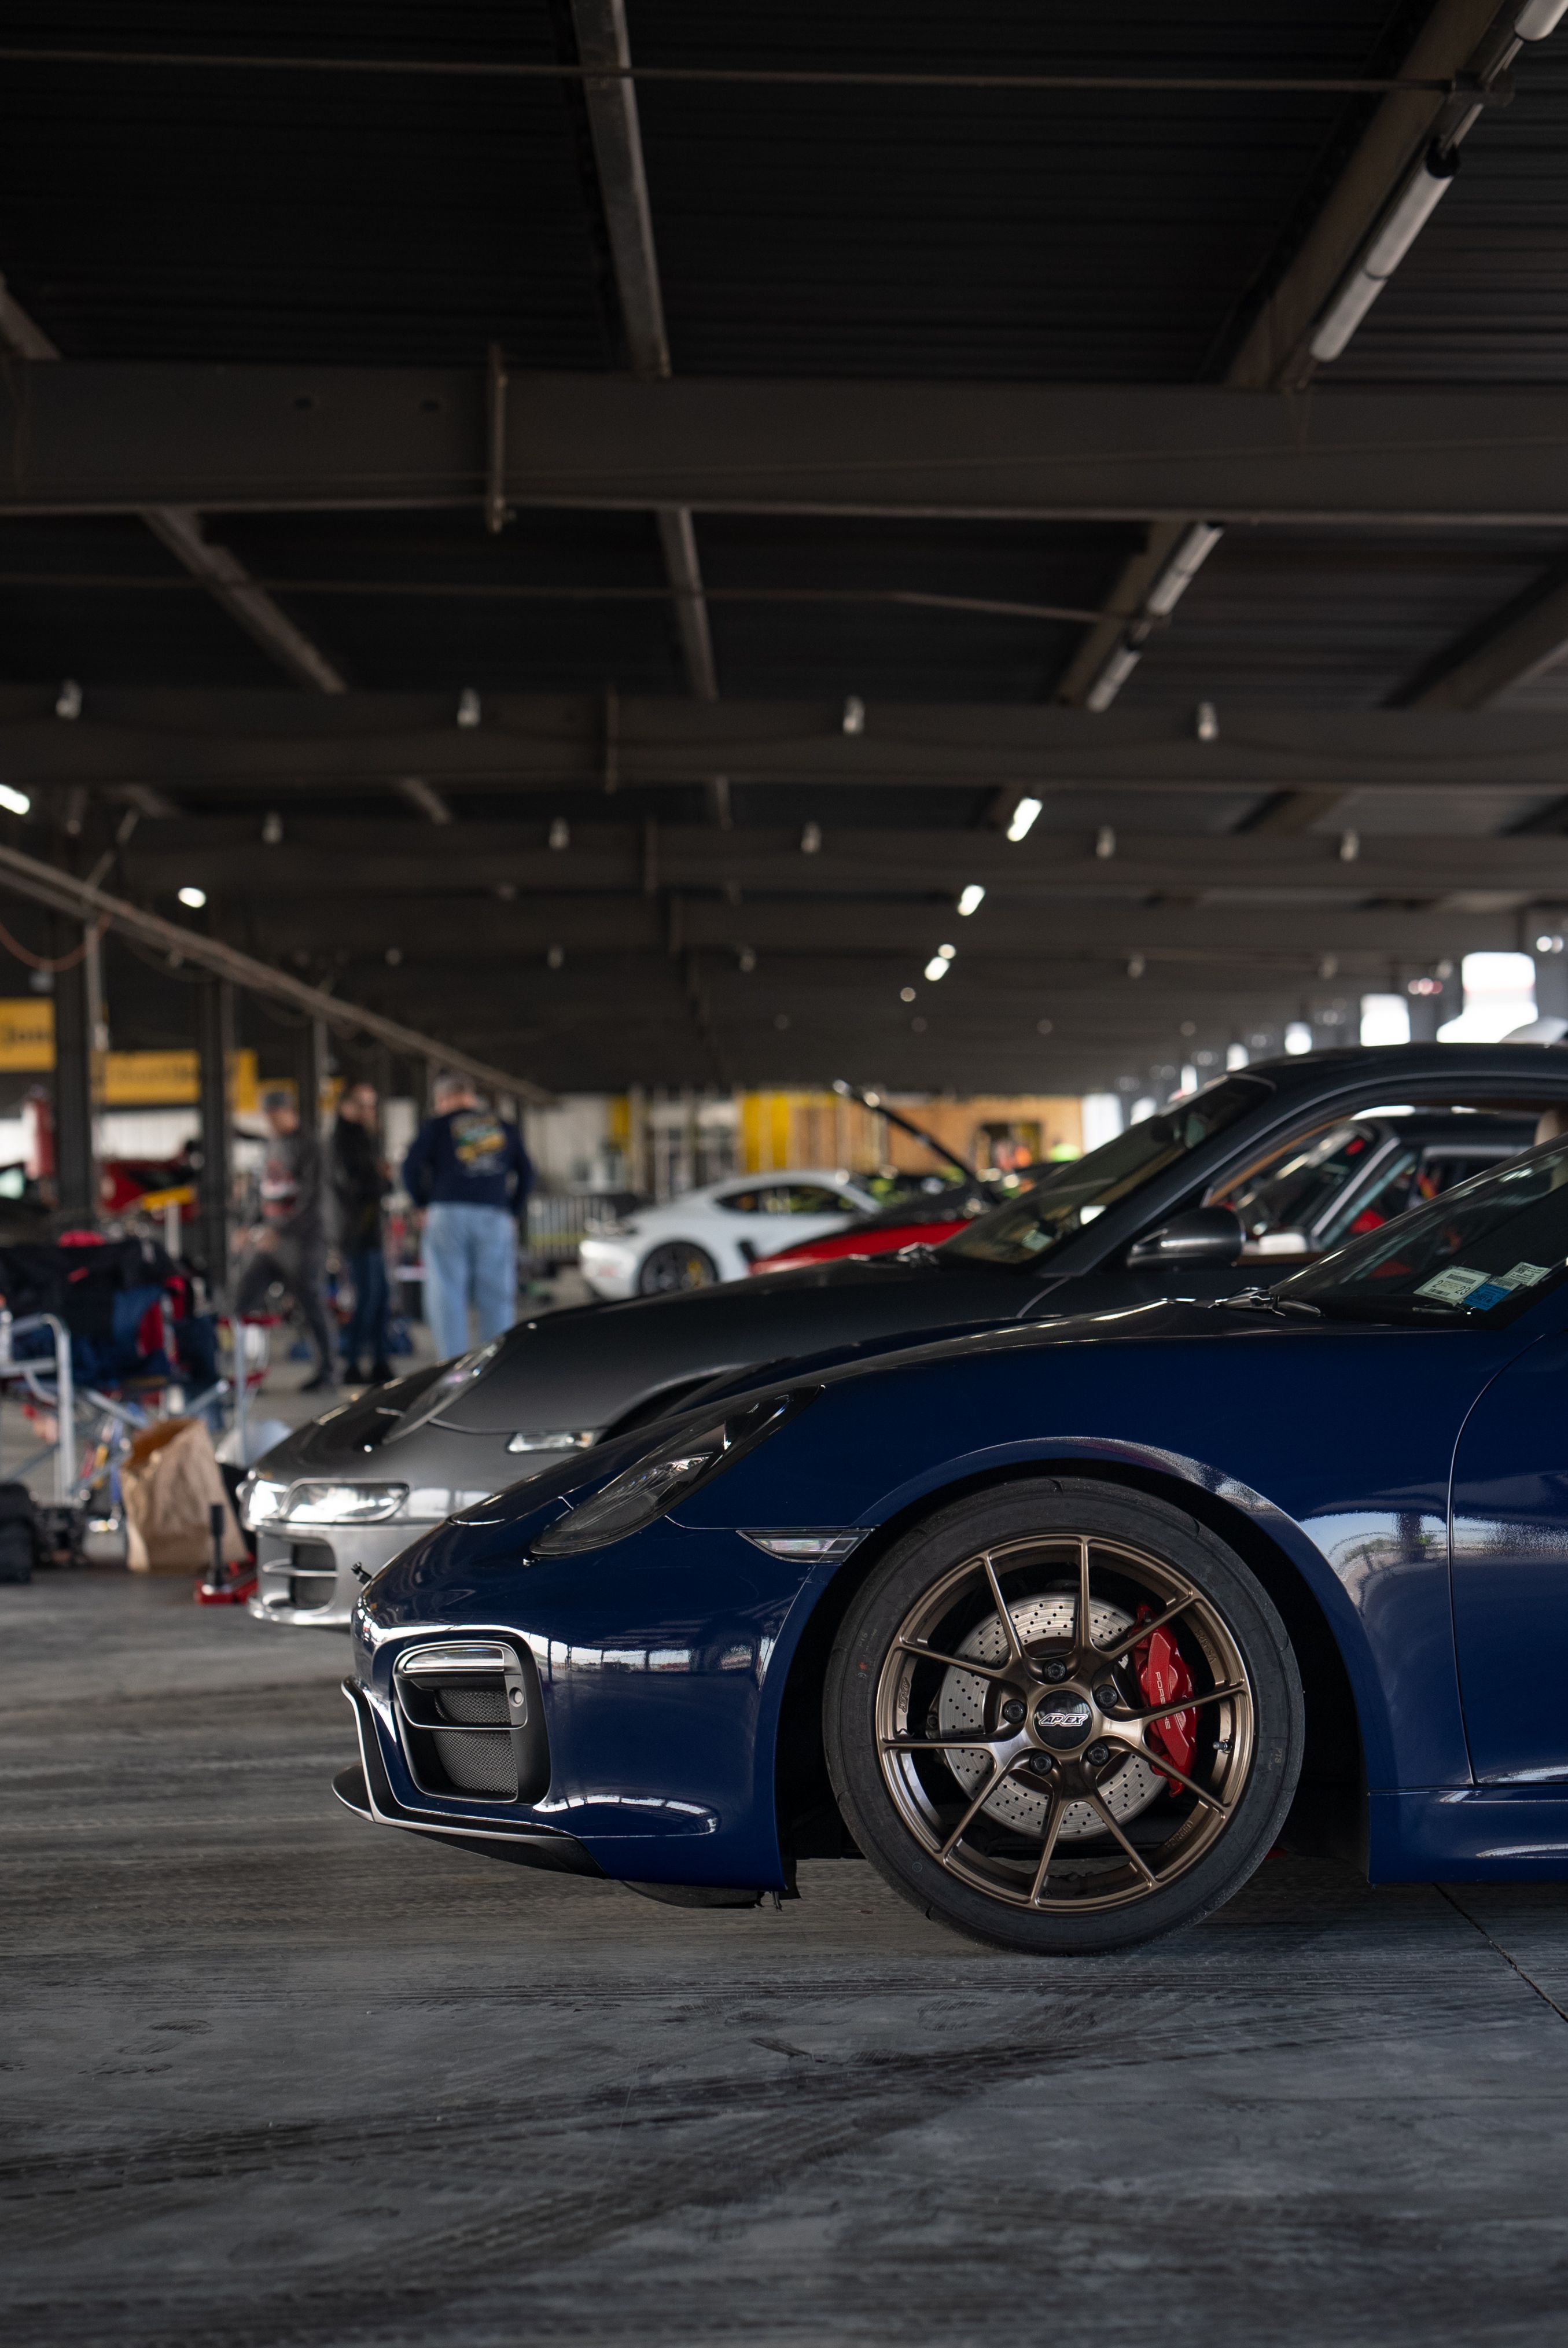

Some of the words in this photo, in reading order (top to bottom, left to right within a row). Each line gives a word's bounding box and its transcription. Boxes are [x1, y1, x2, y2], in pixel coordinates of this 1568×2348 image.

[1432, 1280, 1444, 1288] 2
[1455, 1286, 1471, 1296] 23
[1155, 1671, 1171, 1729] PORSE
[1040, 1714, 1087, 1725] APEX
[1164, 1820, 1194, 1850] FORGED
